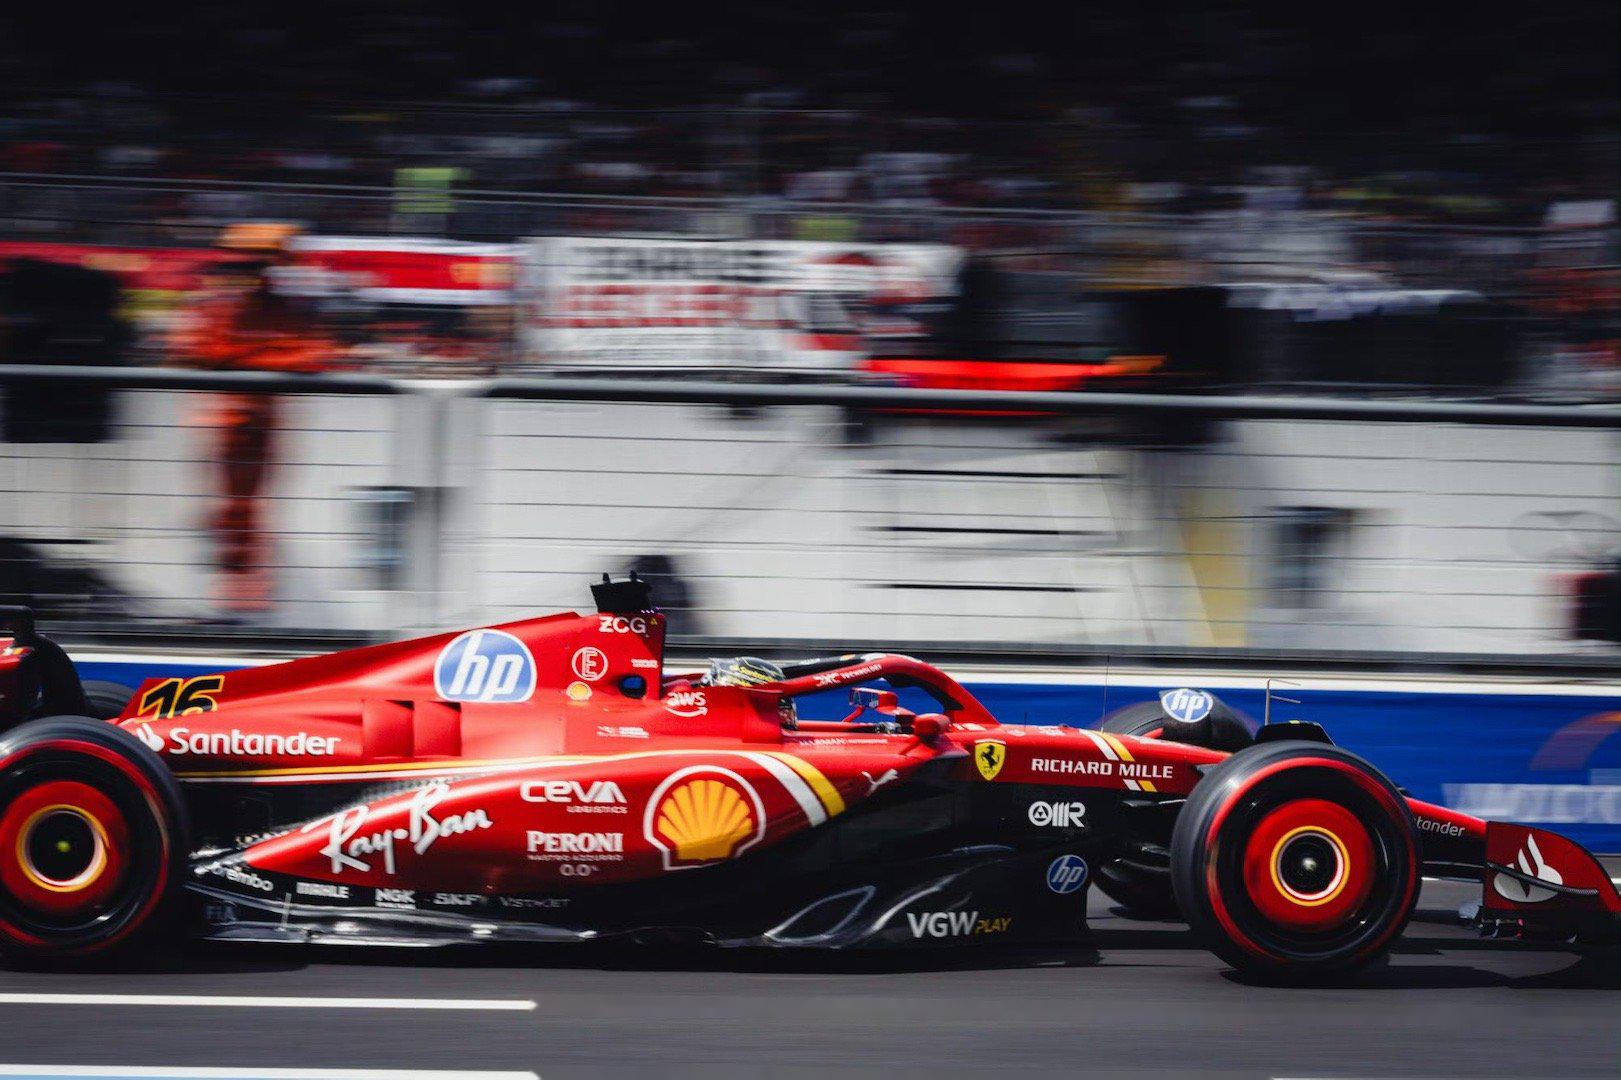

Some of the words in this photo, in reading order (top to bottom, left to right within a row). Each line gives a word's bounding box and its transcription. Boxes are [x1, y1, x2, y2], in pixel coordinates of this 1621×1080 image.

[599, 616, 647, 634] ZCG
[448, 631, 524, 701] hp
[137, 675, 225, 724] 16
[666, 691, 707, 706] aws
[1168, 689, 1206, 722] hp
[169, 727, 341, 756] Santander
[1031, 758, 1113, 776] RICHARD
[1118, 764, 1174, 779] MILLE
[1414, 815, 1466, 838] tander
[526, 830, 624, 853] PERONI
[1051, 856, 1084, 893] hp
[906, 911, 979, 938] VGW
[975, 917, 1011, 933] PLAY
